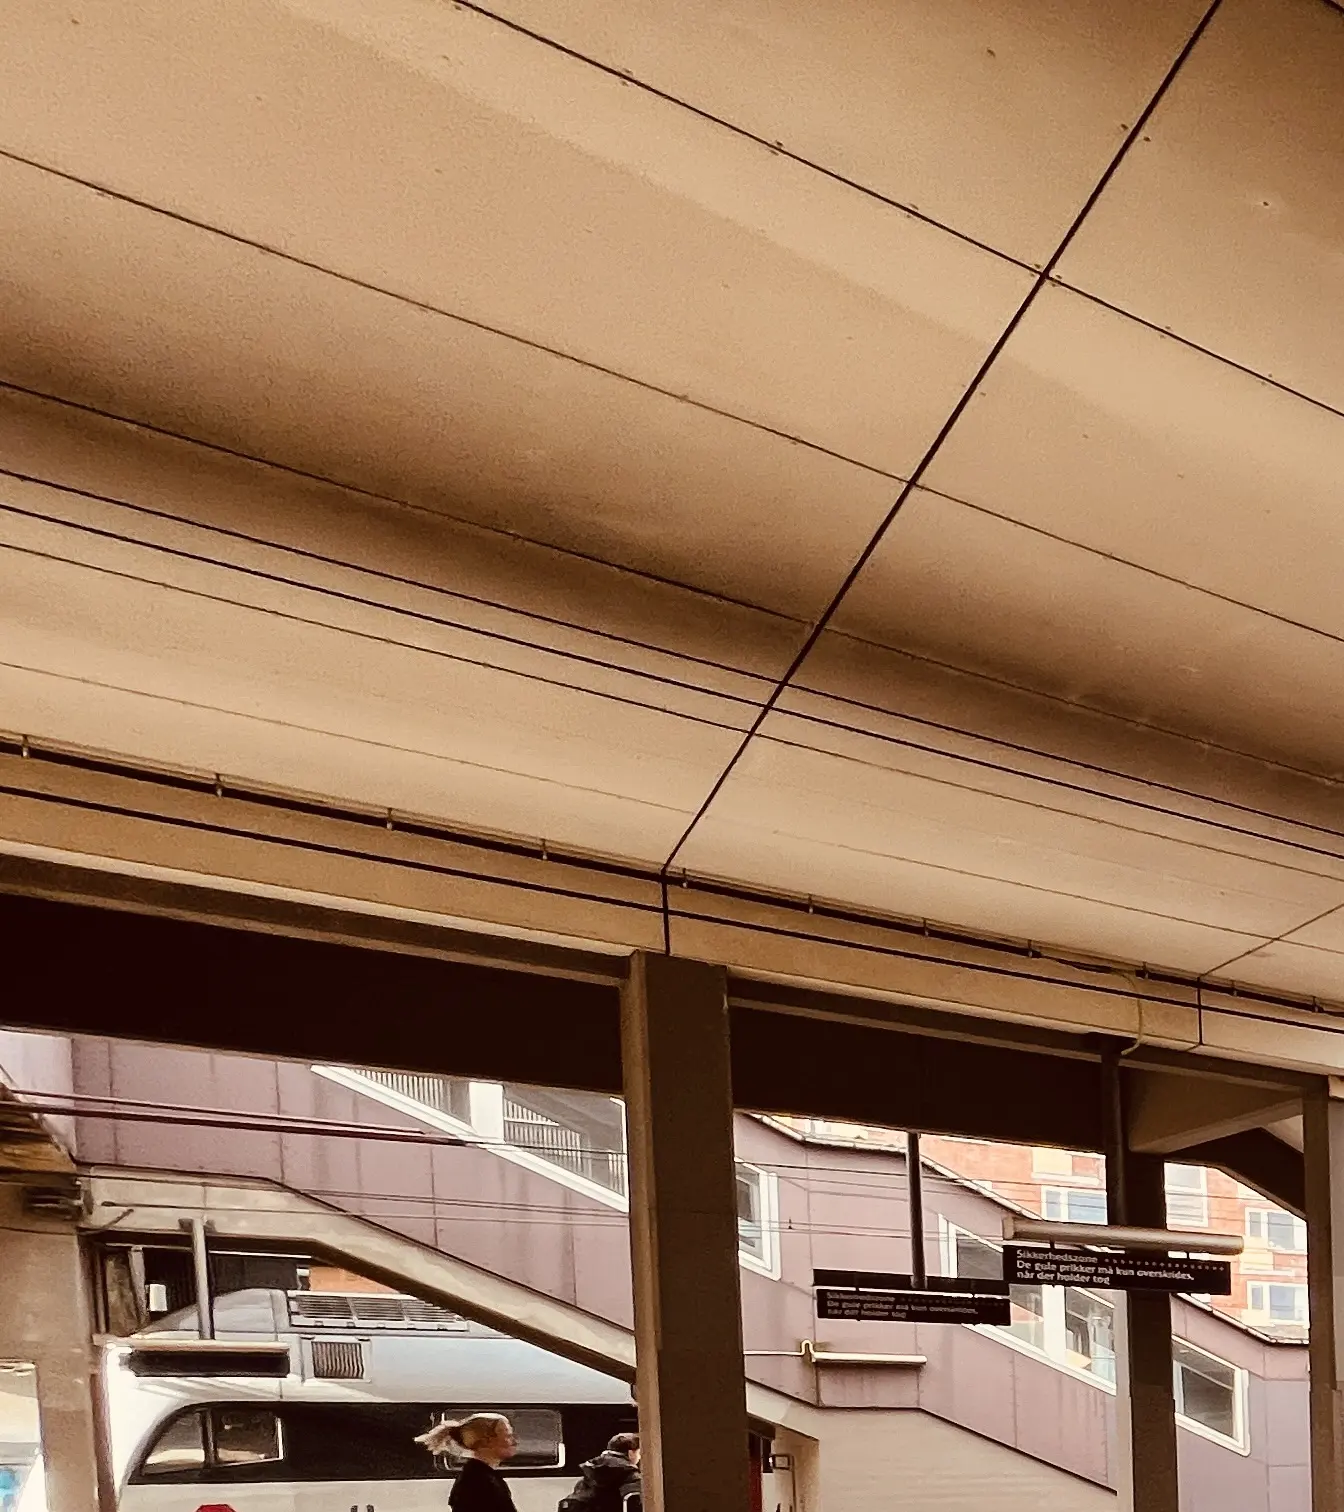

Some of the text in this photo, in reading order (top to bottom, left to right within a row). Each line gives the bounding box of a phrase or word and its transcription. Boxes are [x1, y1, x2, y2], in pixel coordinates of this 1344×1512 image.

[1016, 1260, 1032, 1269] De
[1059, 1264, 1096, 1274] prikker
[1093, 1275, 1110, 1285] tog
